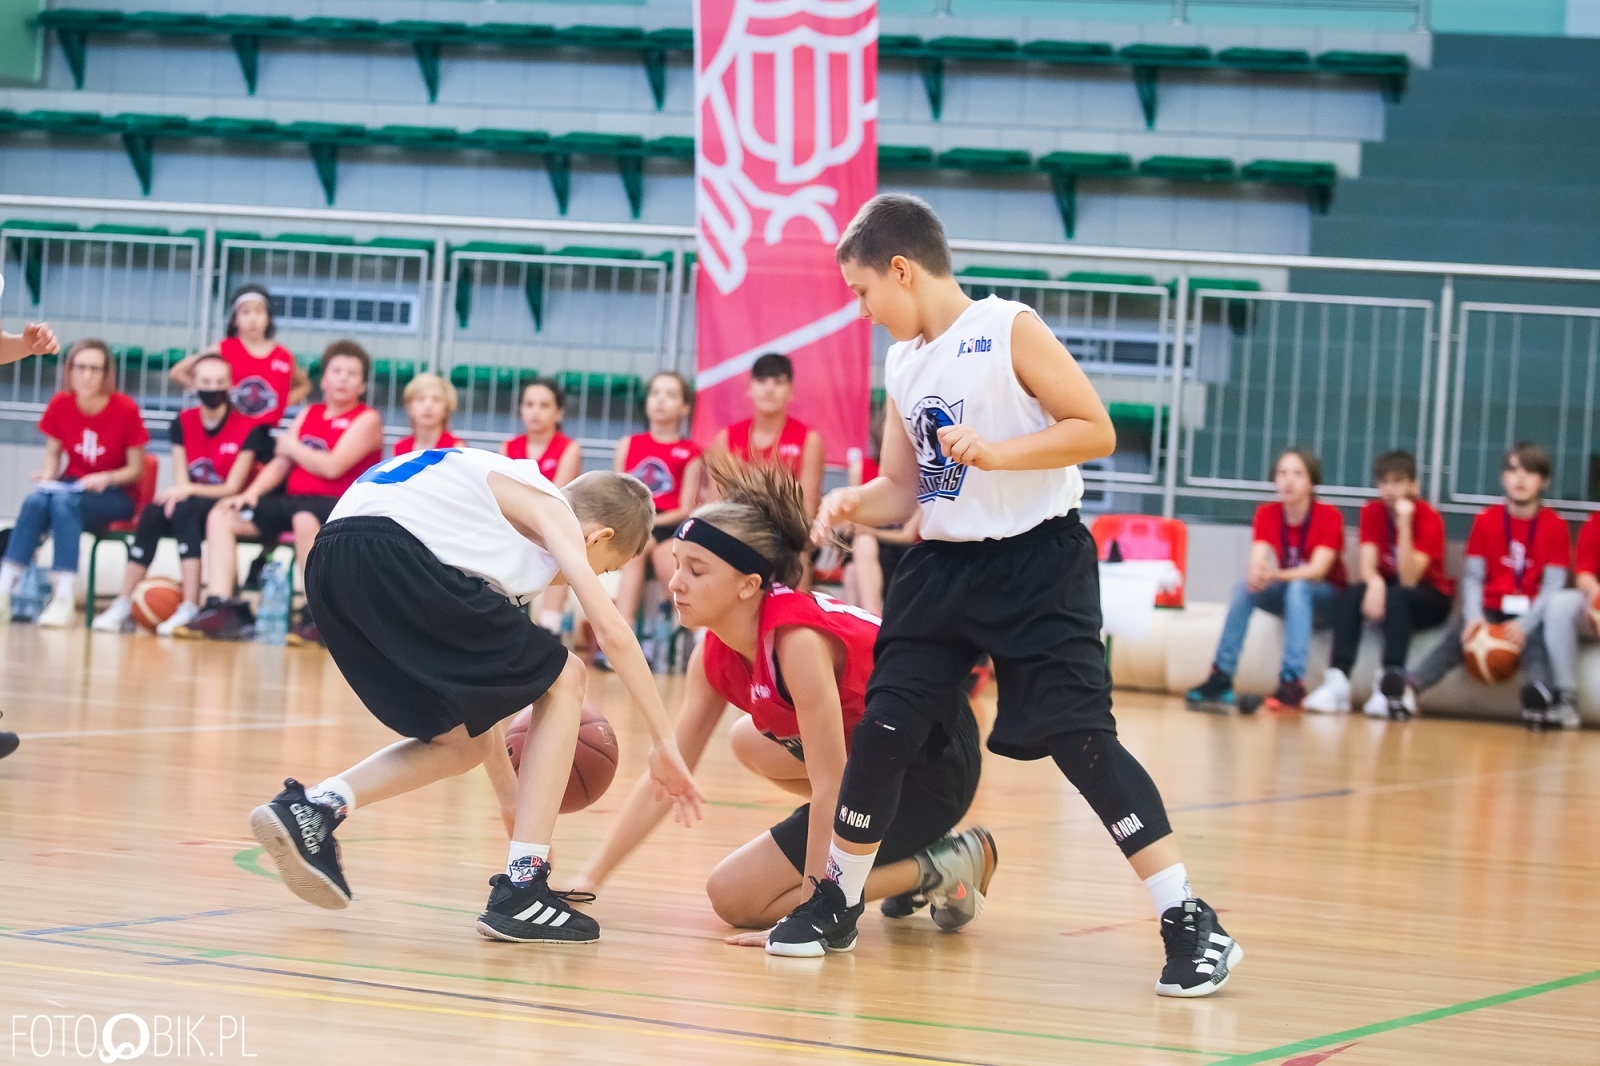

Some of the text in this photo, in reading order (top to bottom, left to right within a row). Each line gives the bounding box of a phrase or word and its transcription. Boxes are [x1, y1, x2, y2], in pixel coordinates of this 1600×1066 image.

[974, 335, 992, 353] nba
[846, 809, 871, 829] NBA
[1116, 812, 1145, 838] NBA
